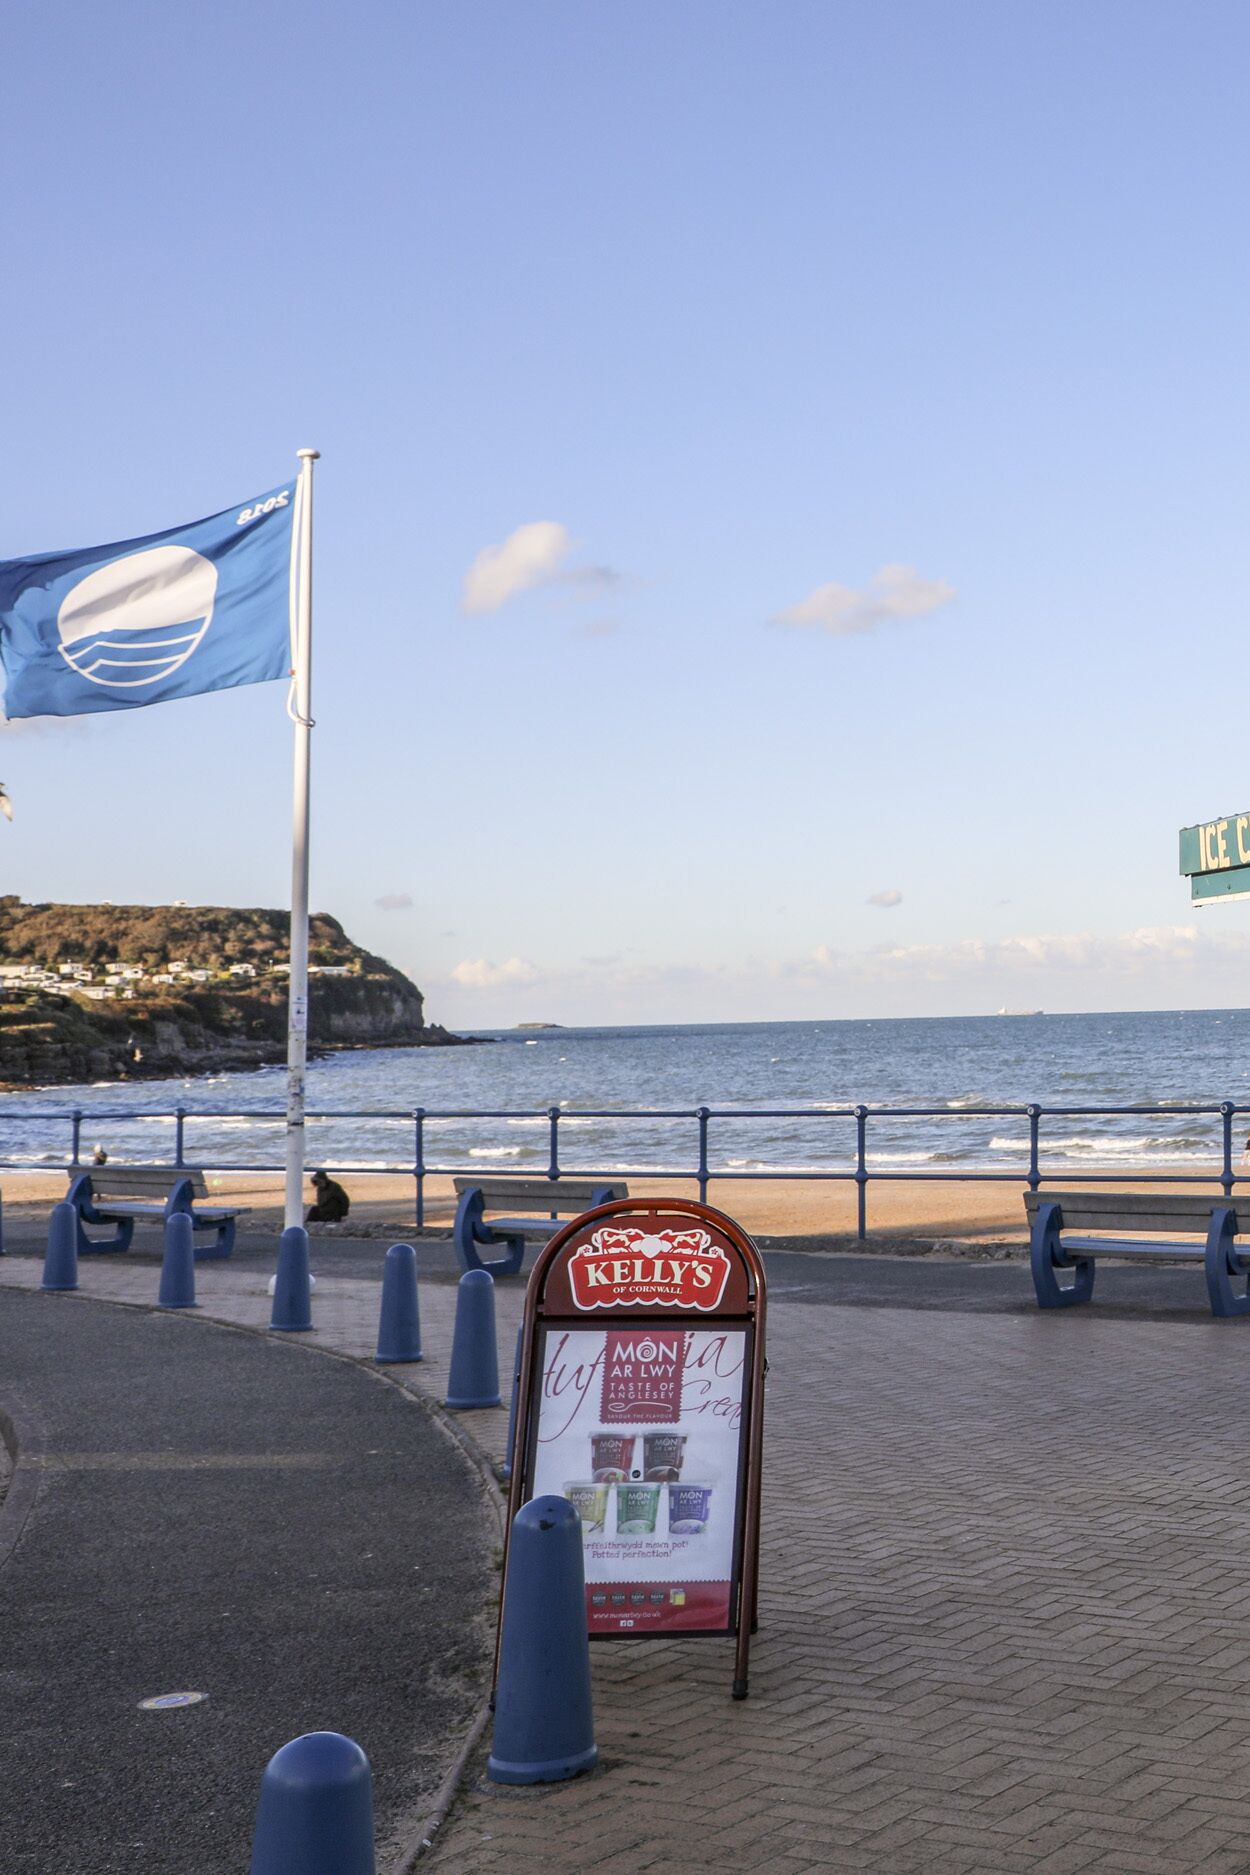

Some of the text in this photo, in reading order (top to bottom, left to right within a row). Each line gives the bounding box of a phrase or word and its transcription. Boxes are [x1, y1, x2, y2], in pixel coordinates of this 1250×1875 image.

[1198, 823, 1231, 871] ICE
[585, 1259, 714, 1289] KELLY'S
[613, 1285, 683, 1295] OF CORNWALL
[612, 1337, 677, 1364] MÔN
[611, 1364, 676, 1378] AR LWY
[609, 1382, 674, 1391] TASTE OF
[609, 1390, 674, 1399] ANGLESEY
[592, 1550, 672, 1560] Potted perfection!
